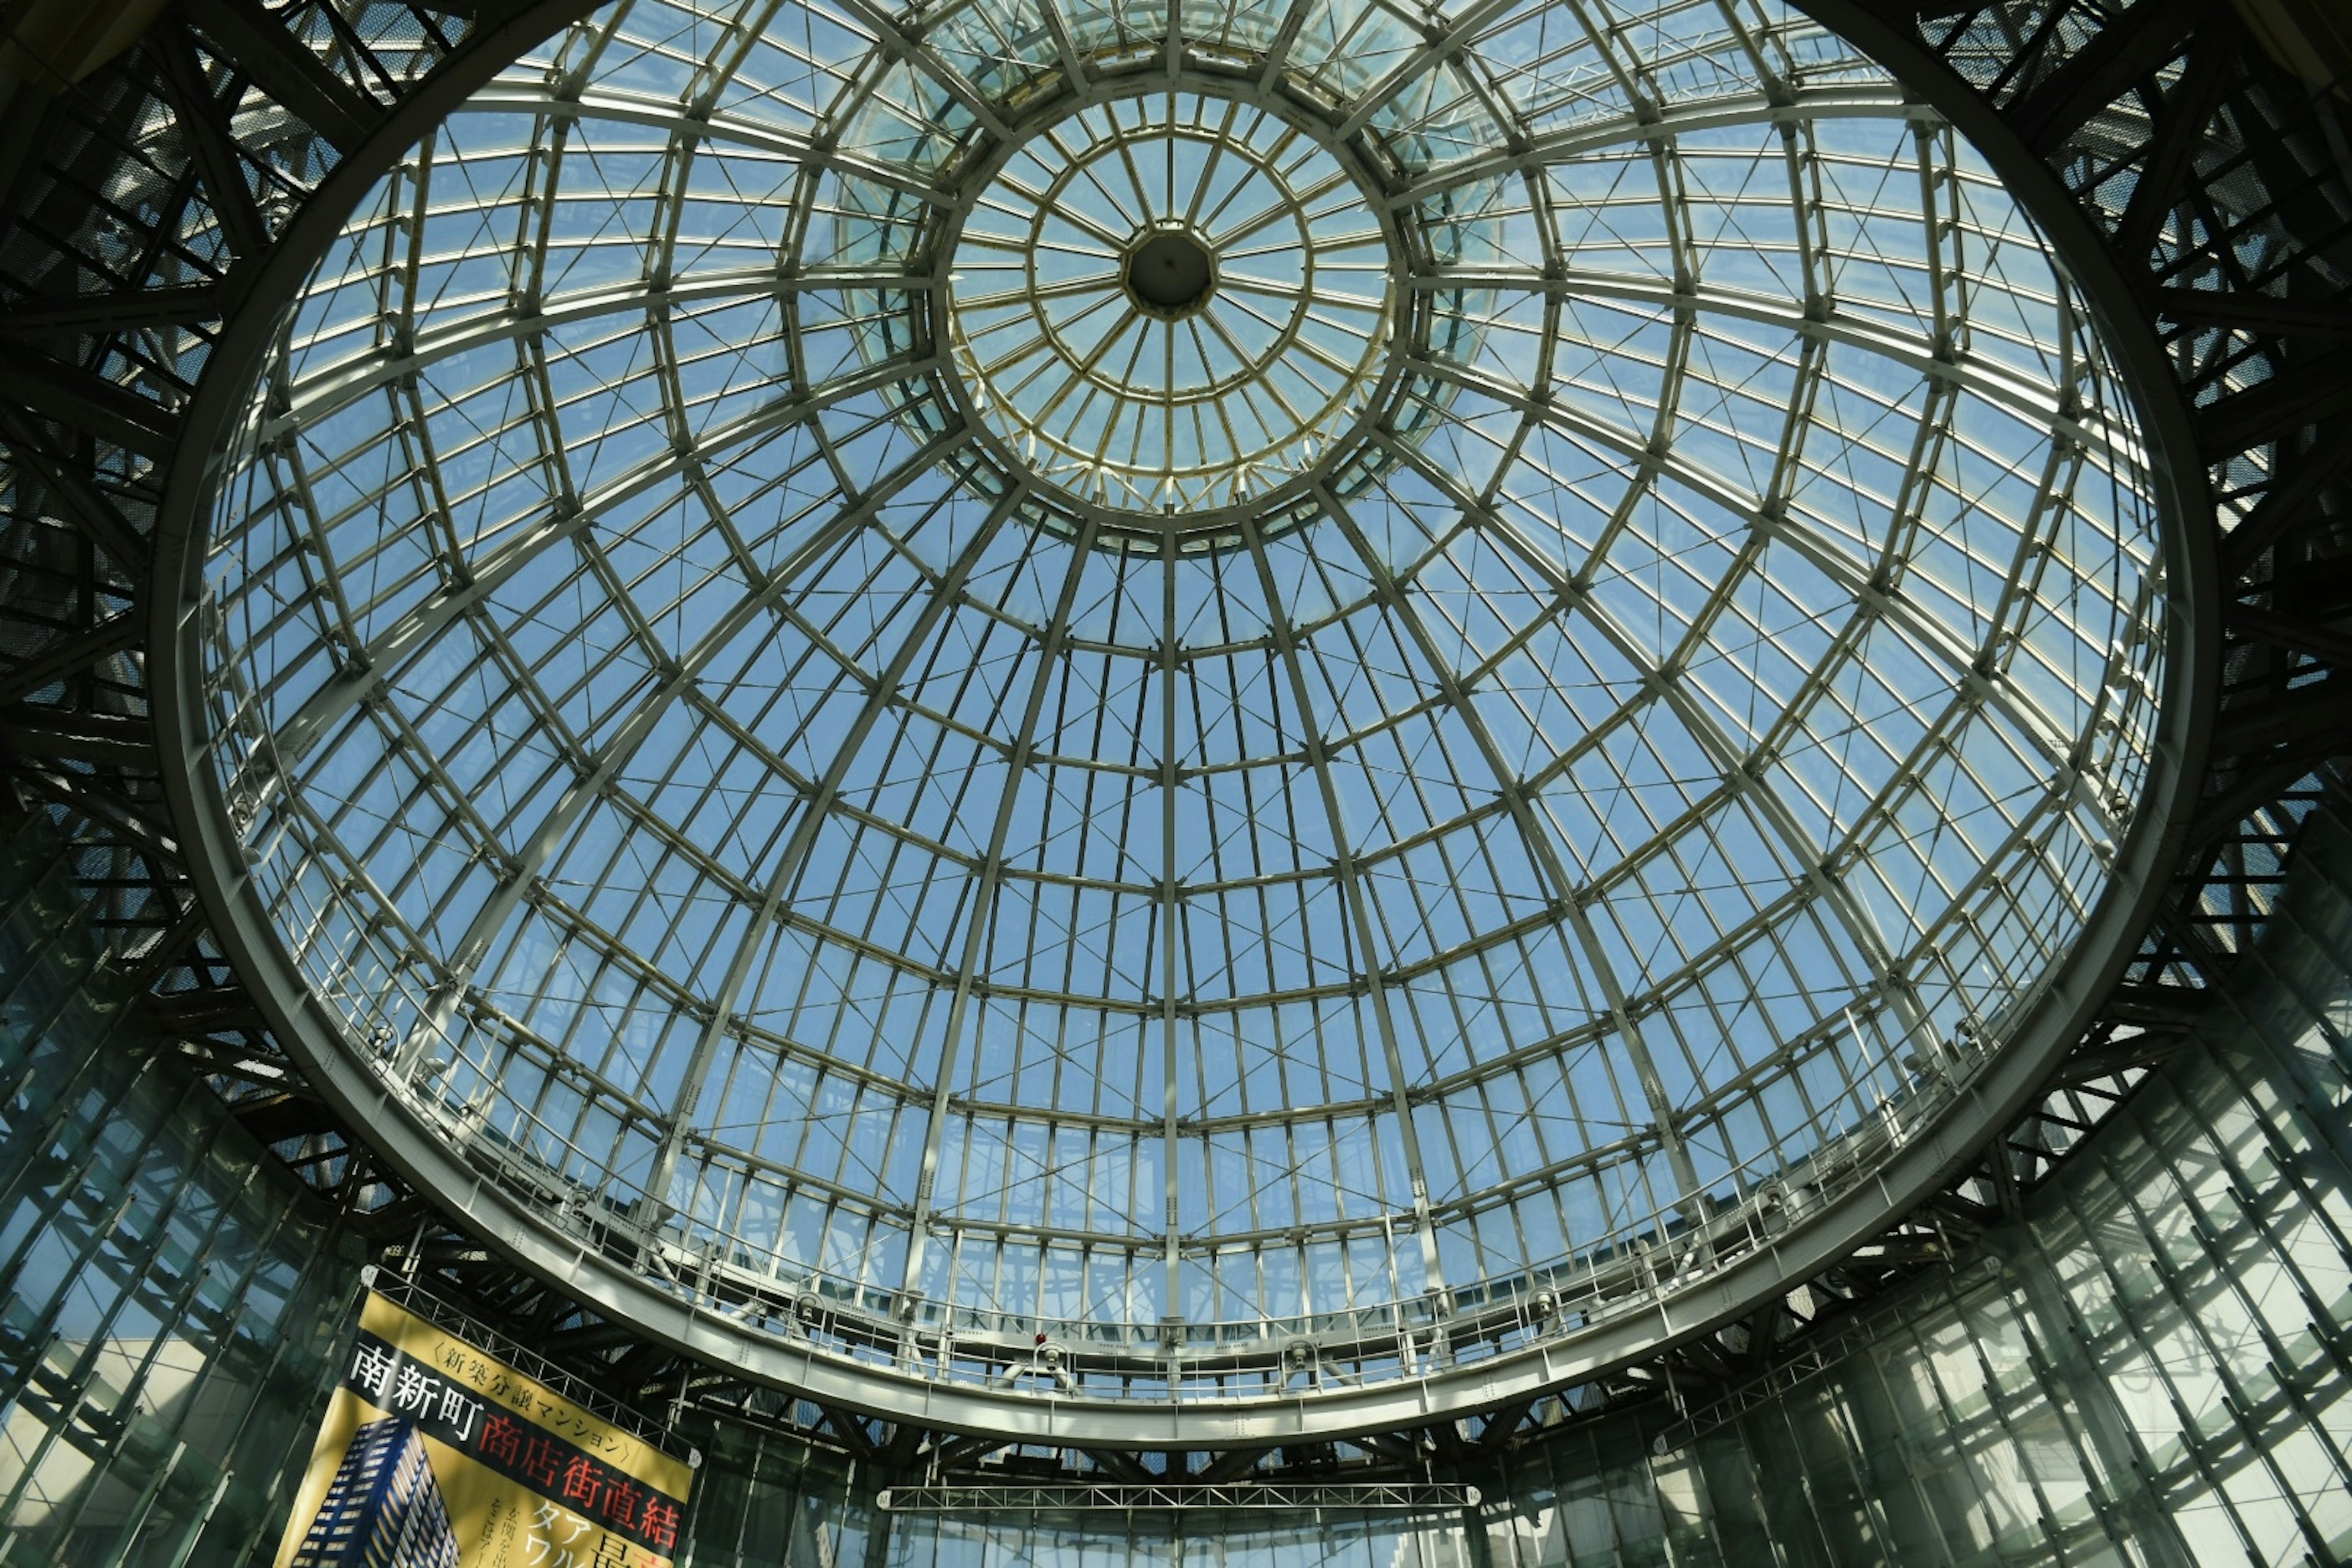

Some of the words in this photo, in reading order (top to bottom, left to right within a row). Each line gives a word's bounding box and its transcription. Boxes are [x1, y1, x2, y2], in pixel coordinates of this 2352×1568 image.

[350, 1341, 680, 1548] 南新町商店街直結
